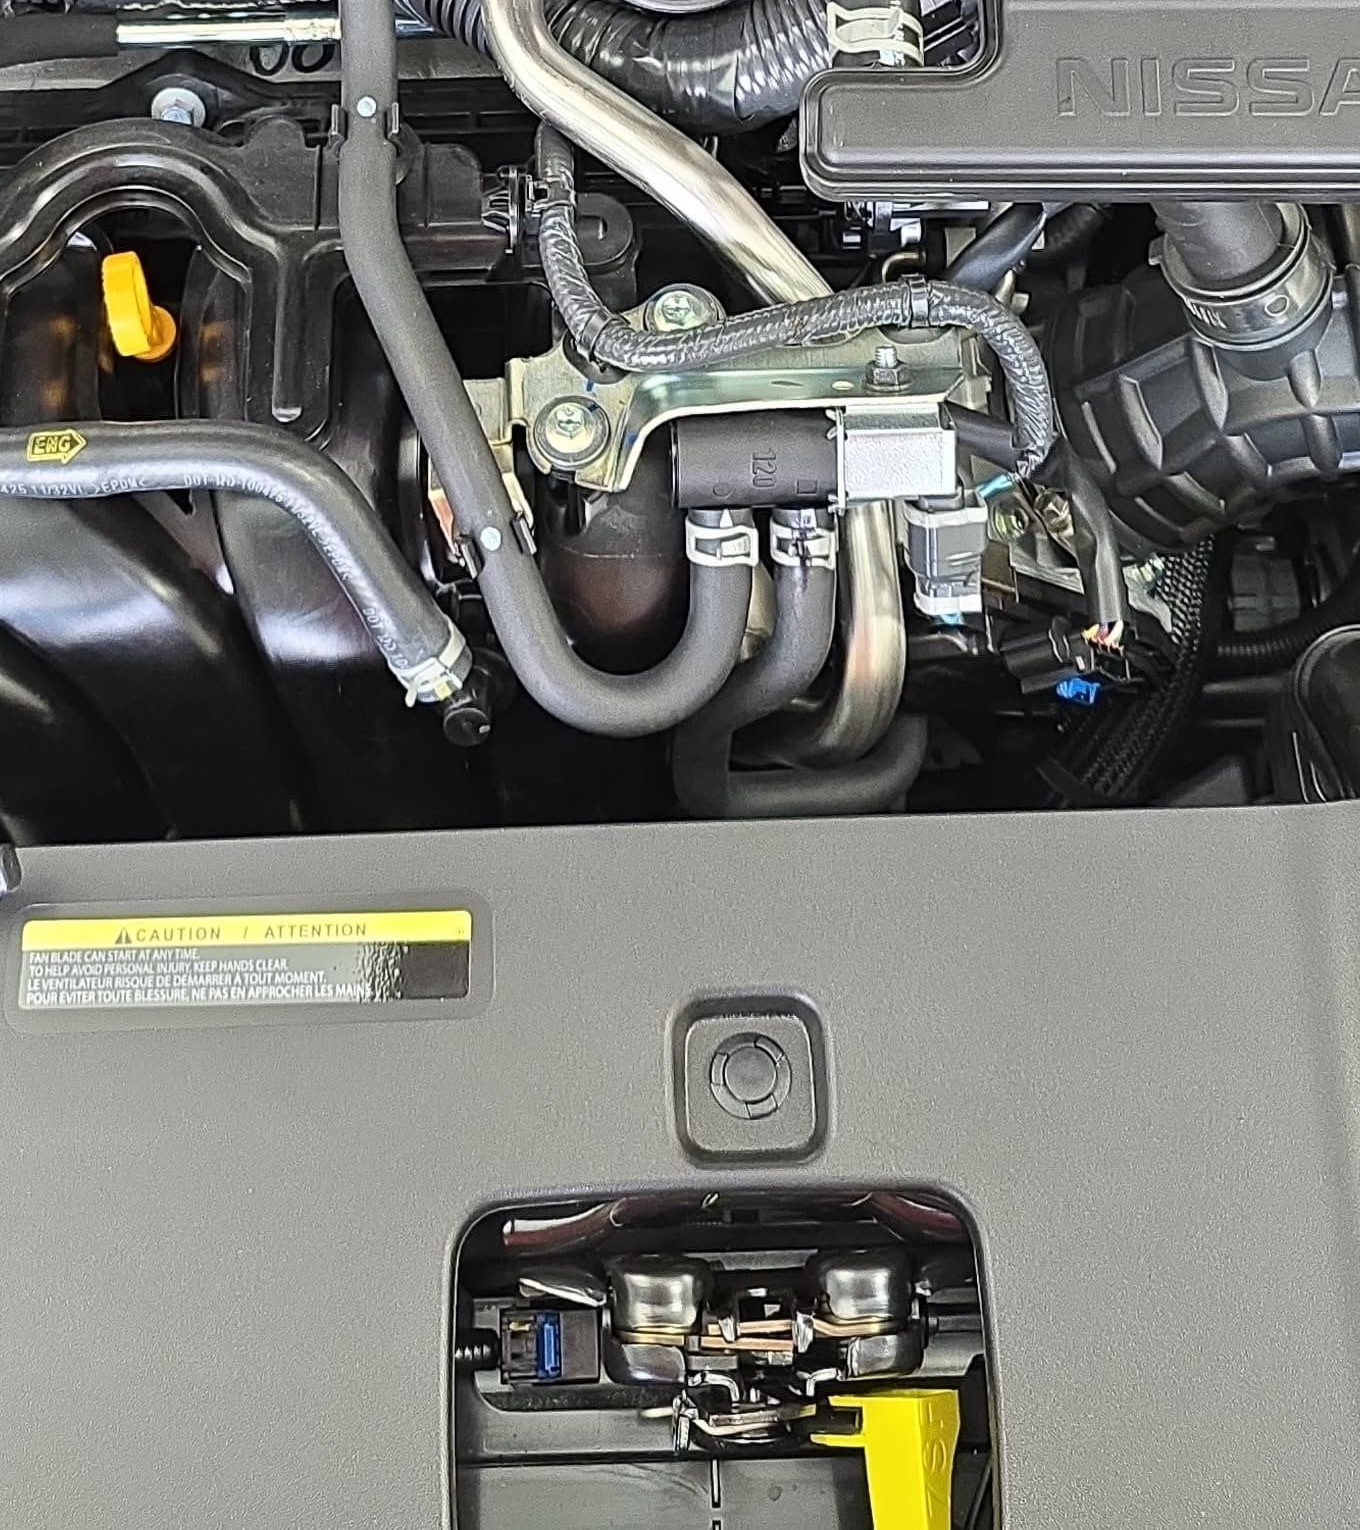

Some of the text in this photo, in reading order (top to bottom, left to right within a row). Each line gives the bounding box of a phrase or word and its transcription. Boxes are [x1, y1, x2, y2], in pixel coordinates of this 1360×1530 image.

[34, 436, 71, 455] ENG
[752, 453, 777, 488] 120
[136, 926, 221, 942] CAUTION
[264, 922, 367, 939] ATTENTION
[30, 950, 51, 964] FAN
[51, 950, 82, 963] BLADE
[84, 950, 106, 962] CAN
[107, 949, 138, 961] START
[138, 949, 152, 960] AT
[152, 949, 173, 960] ANY
[30, 965, 46, 977] TO
[46, 964, 70, 977] HELP
[71, 963, 102, 976] AVOID
[103, 962, 155, 975] PERSONAL
[193, 960, 218, 972] KEEP
[219, 959, 254, 971] HANDS
[27, 978, 41, 990] LE
[41, 977, 112, 990] VENTILATEUR
[114, 975, 154, 988] RISQUE
[156, 975, 171, 987] DE
[244, 972, 273, 984] TOUT
[26, 992, 58, 1004] POUR
[97, 990, 133, 1003] TOUTE
[191, 988, 207, 1000] NE
[208, 987, 229, 999] PAS
[230, 986, 247, 998] EN
[248, 985, 313, 999] APPROCHER
[315, 984, 334, 997] LES
